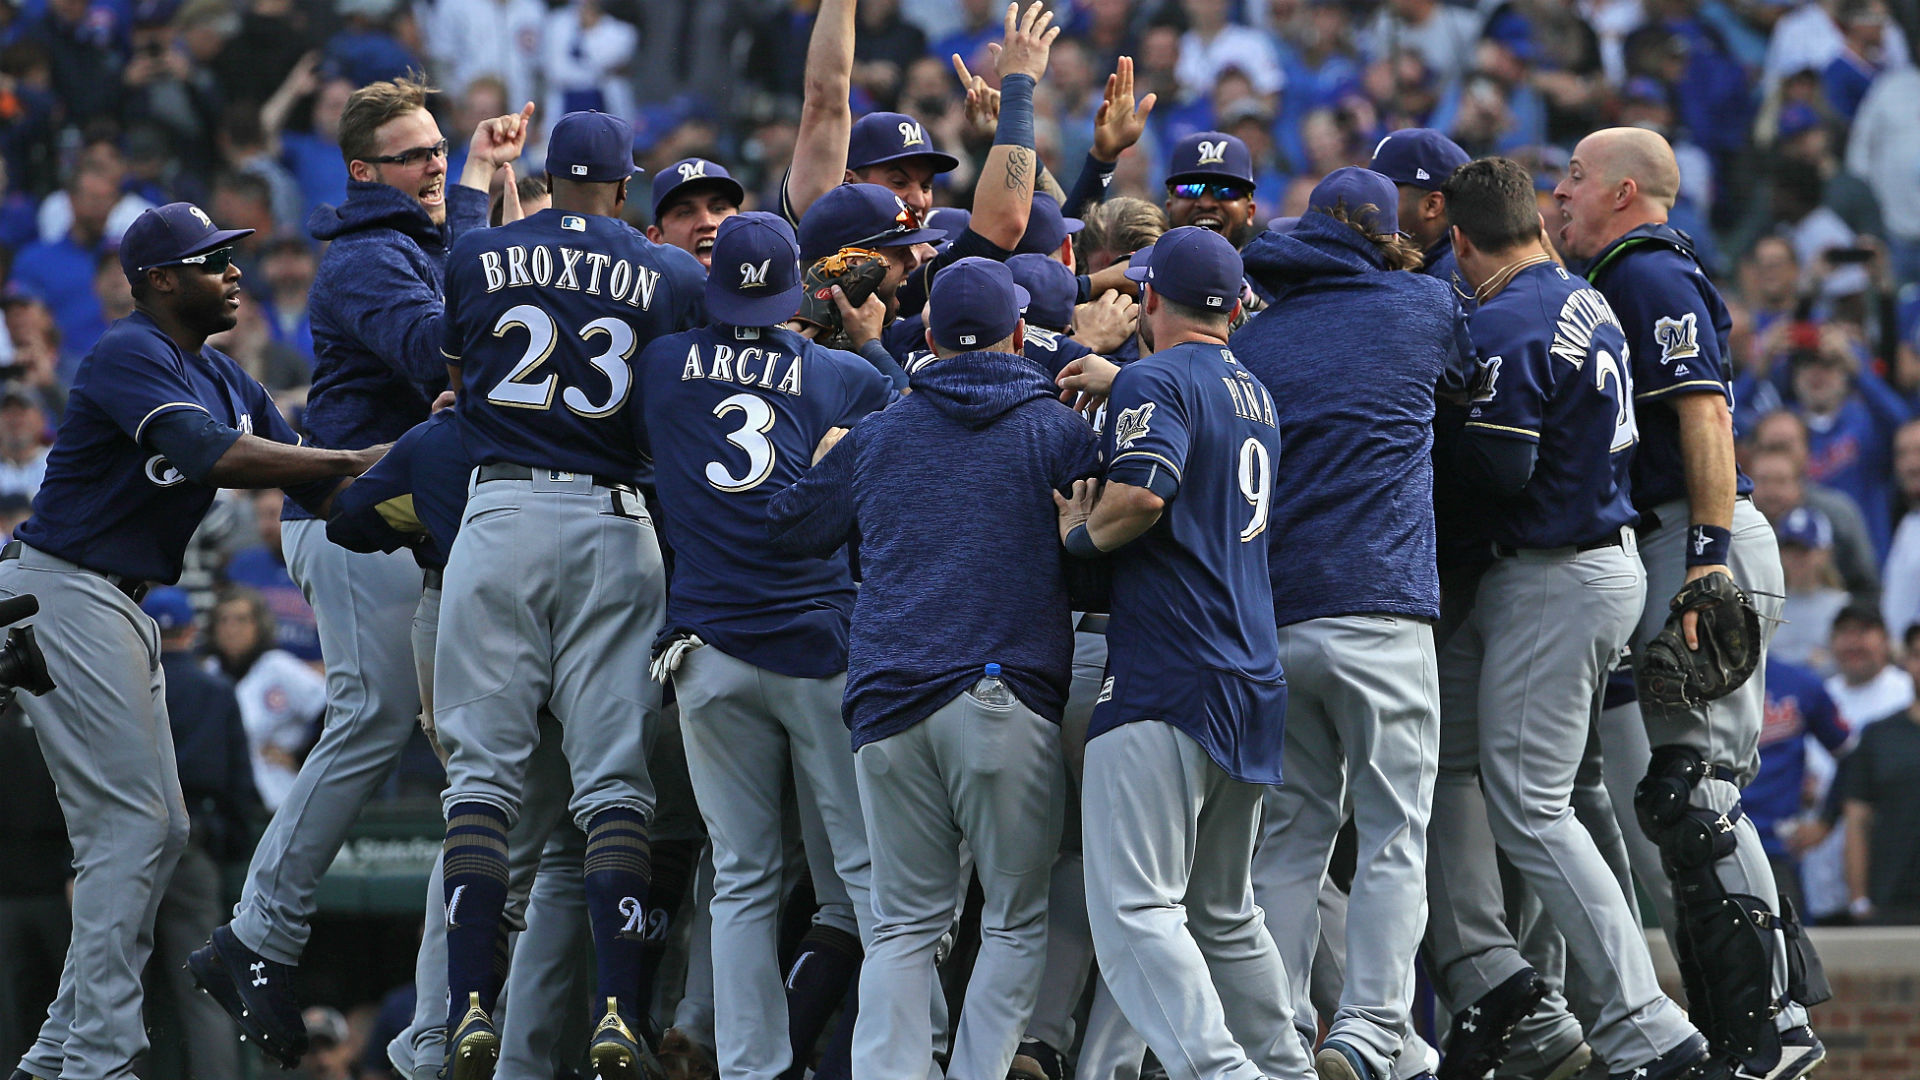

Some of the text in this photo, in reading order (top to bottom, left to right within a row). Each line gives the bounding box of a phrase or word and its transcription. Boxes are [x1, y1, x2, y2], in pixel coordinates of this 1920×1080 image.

[479, 245, 661, 311] BROXTON
[485, 304, 639, 419] 23
[681, 343, 802, 396] ARCIA
[705, 393, 776, 493] 3
[1238, 437, 1272, 543] 9
